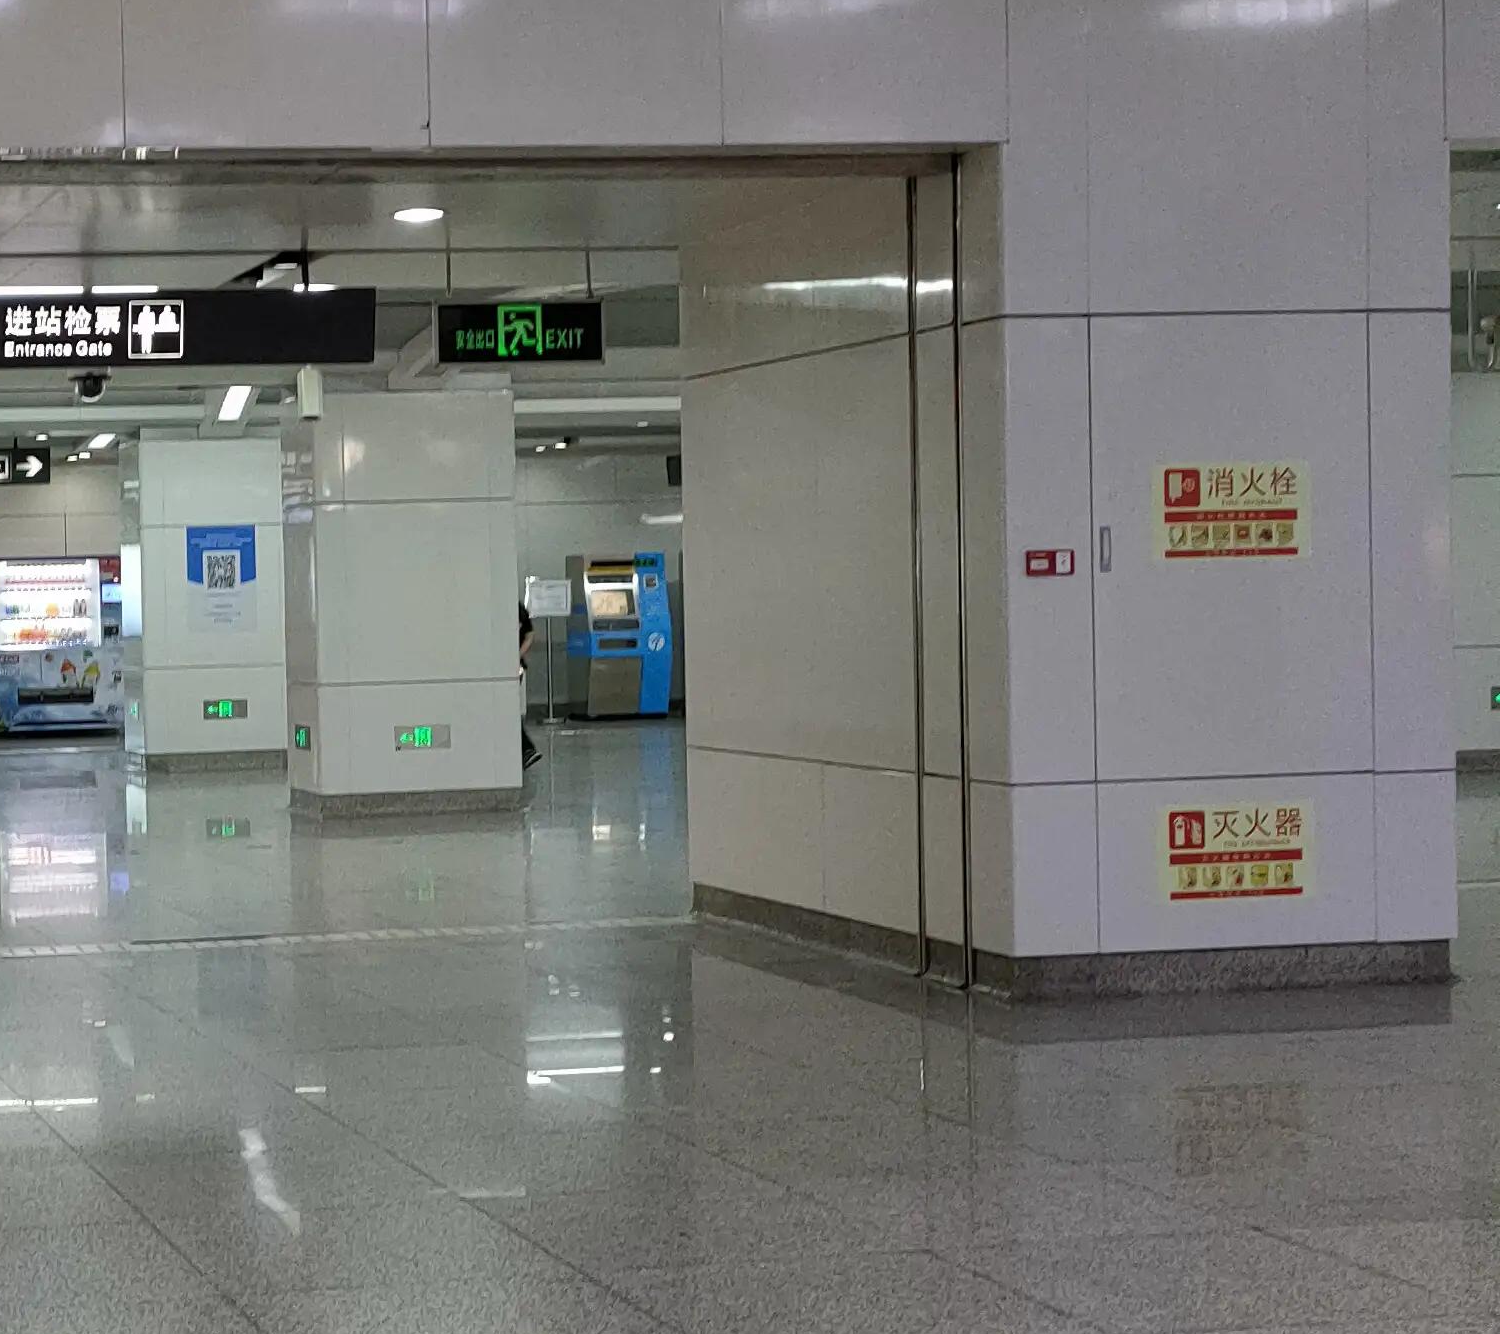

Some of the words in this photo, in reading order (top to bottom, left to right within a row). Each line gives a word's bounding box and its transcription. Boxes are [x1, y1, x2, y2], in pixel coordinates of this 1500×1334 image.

[4, 304, 121, 336] 进站检票
[4, 341, 73, 358] Entrance
[75, 340, 113, 357] Gate
[545, 328, 584, 350] EXIT
[1206, 466, 1298, 500] 消火栓
[1211, 807, 1302, 840] 灭火器
